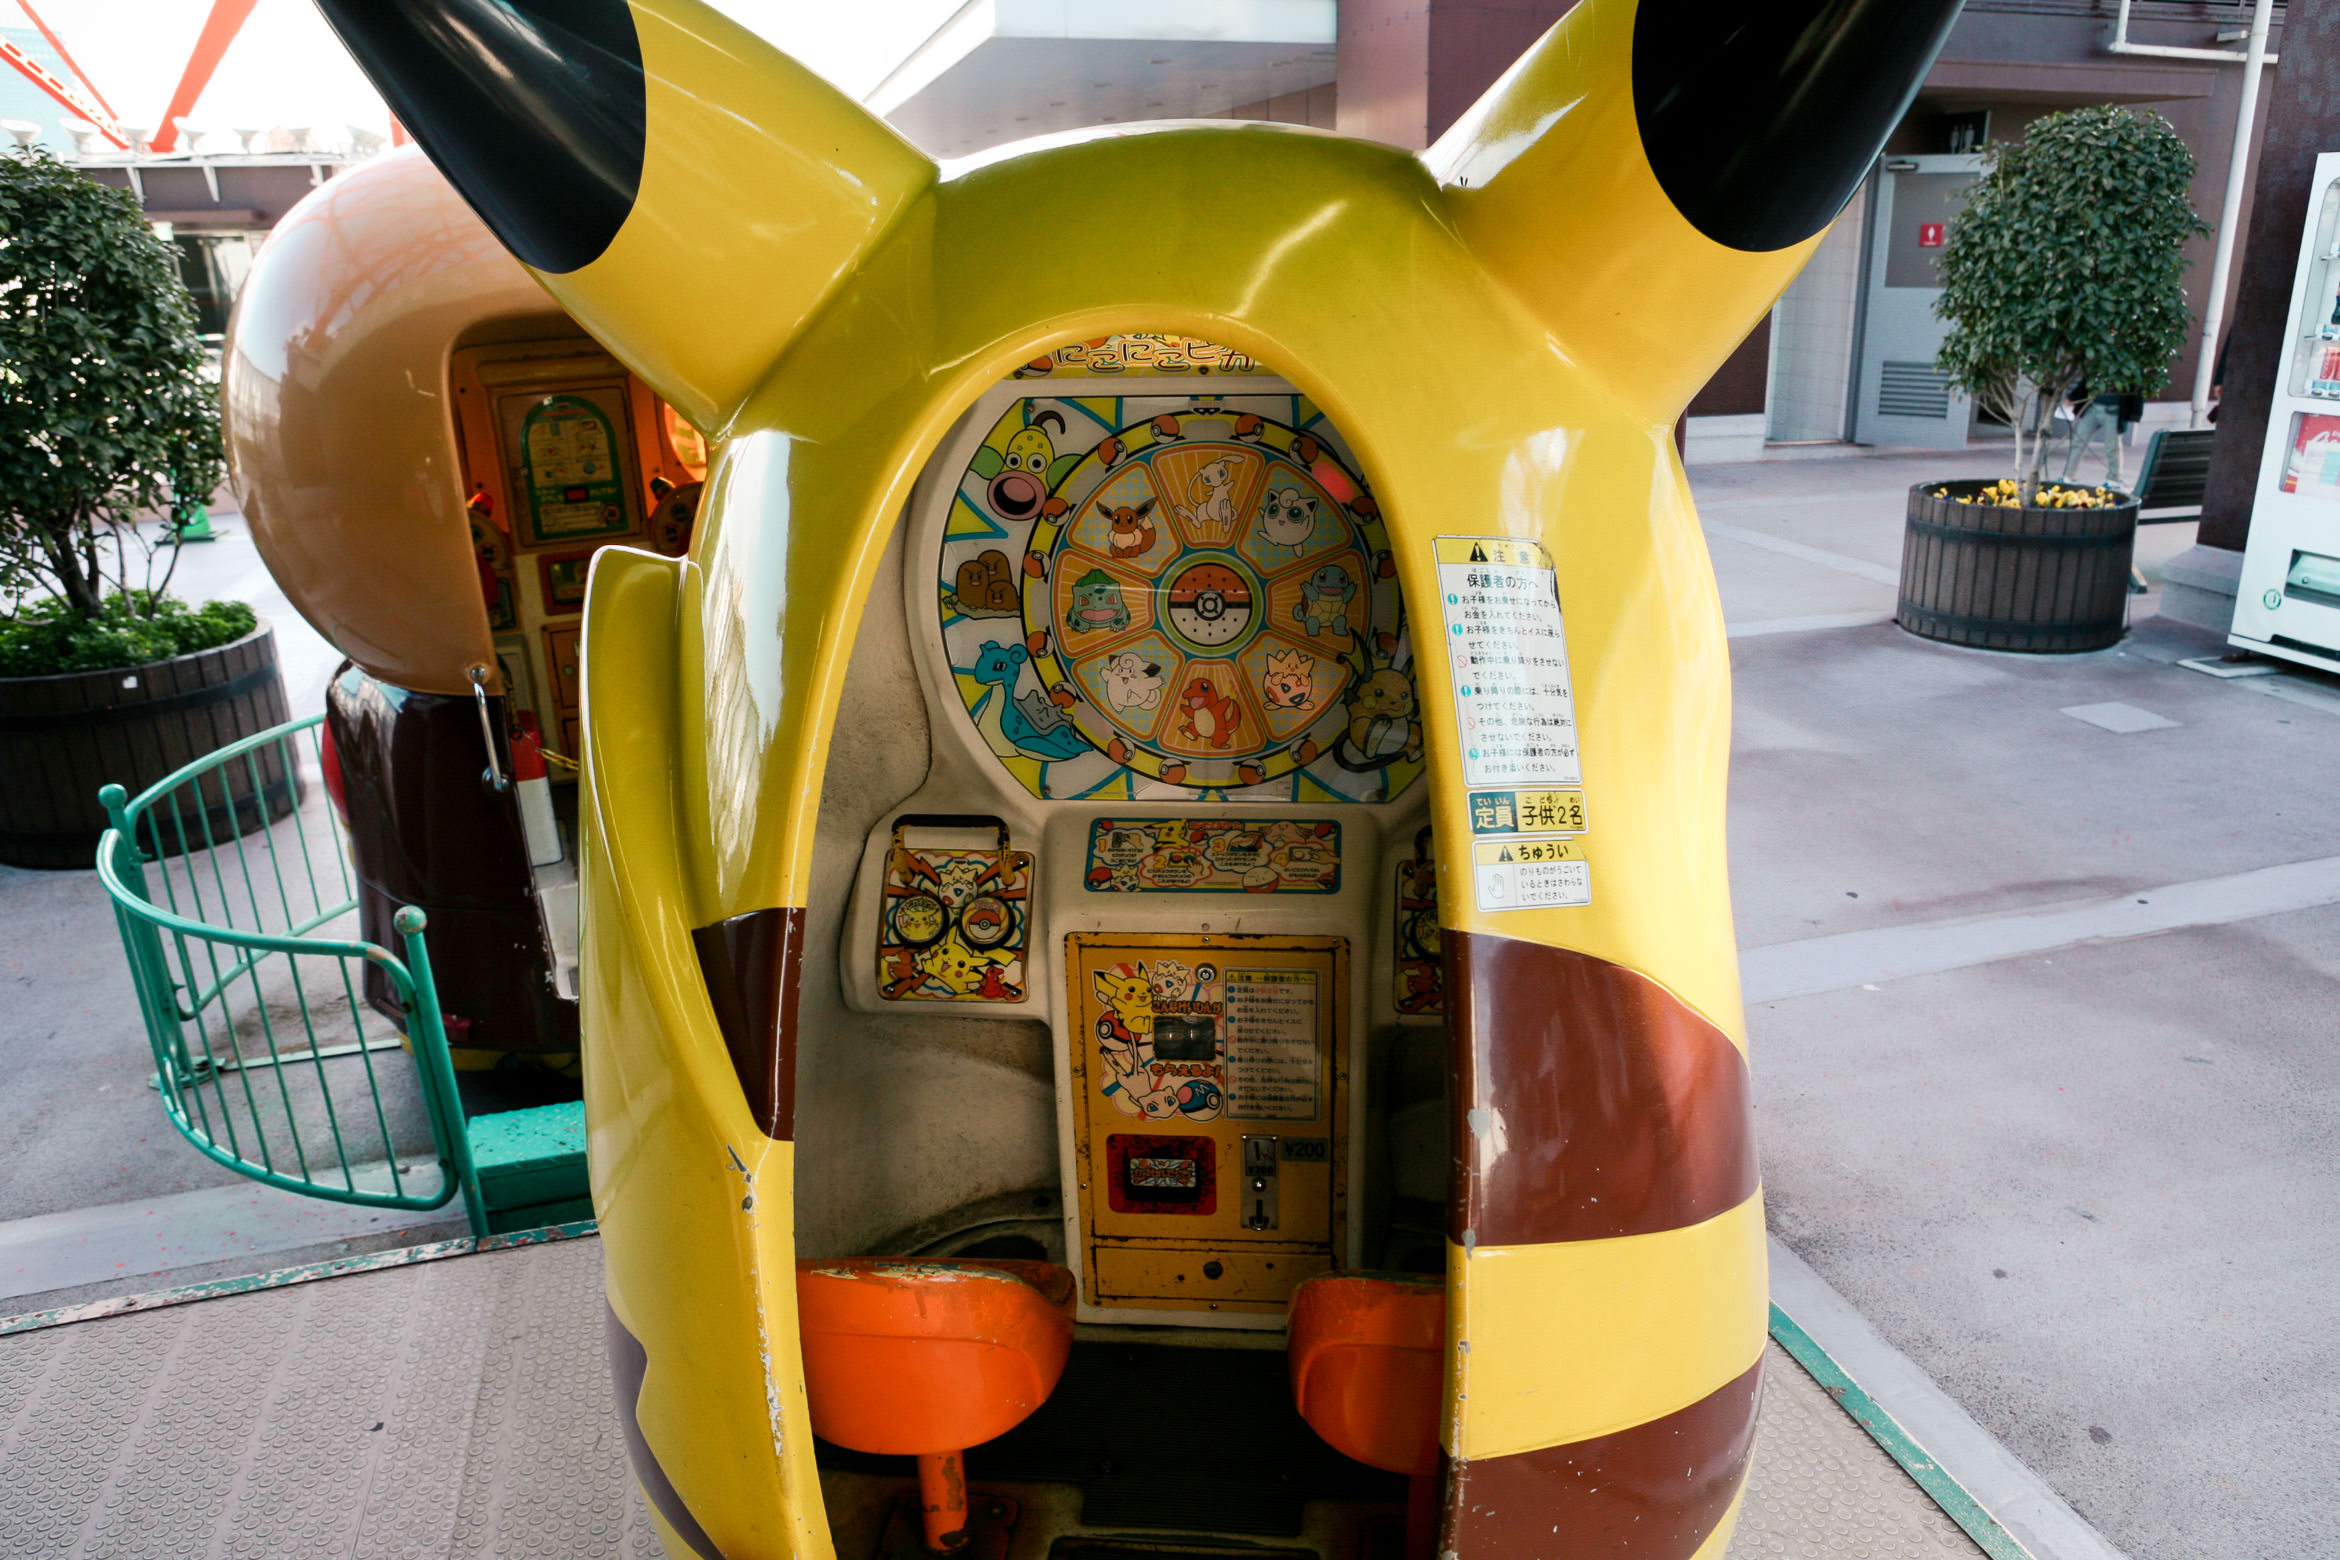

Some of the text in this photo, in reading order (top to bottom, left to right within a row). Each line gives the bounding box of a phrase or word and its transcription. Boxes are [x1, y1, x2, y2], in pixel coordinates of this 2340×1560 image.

[1466, 573, 1538, 590] 保護者の方へ
[1465, 610, 1543, 622] お金を入れてください。
[1476, 702, 1535, 712] つけてください。
[1474, 805, 1515, 829] 定員
[1521, 804, 1583, 826] 子供2名
[1097, 838, 1107, 853] 1
[1211, 837, 1226, 853] 3
[1518, 843, 1569, 861] ちゅうい
[1152, 854, 1168, 869] 2
[1272, 852, 1290, 868] 4
[1519, 865, 1583, 877] のりものがうごいて
[1520, 878, 1583, 890] いるときはさわらな
[1150, 1062, 1222, 1079] もらえるよ!
[1284, 1142, 1325, 1158] ¥200
